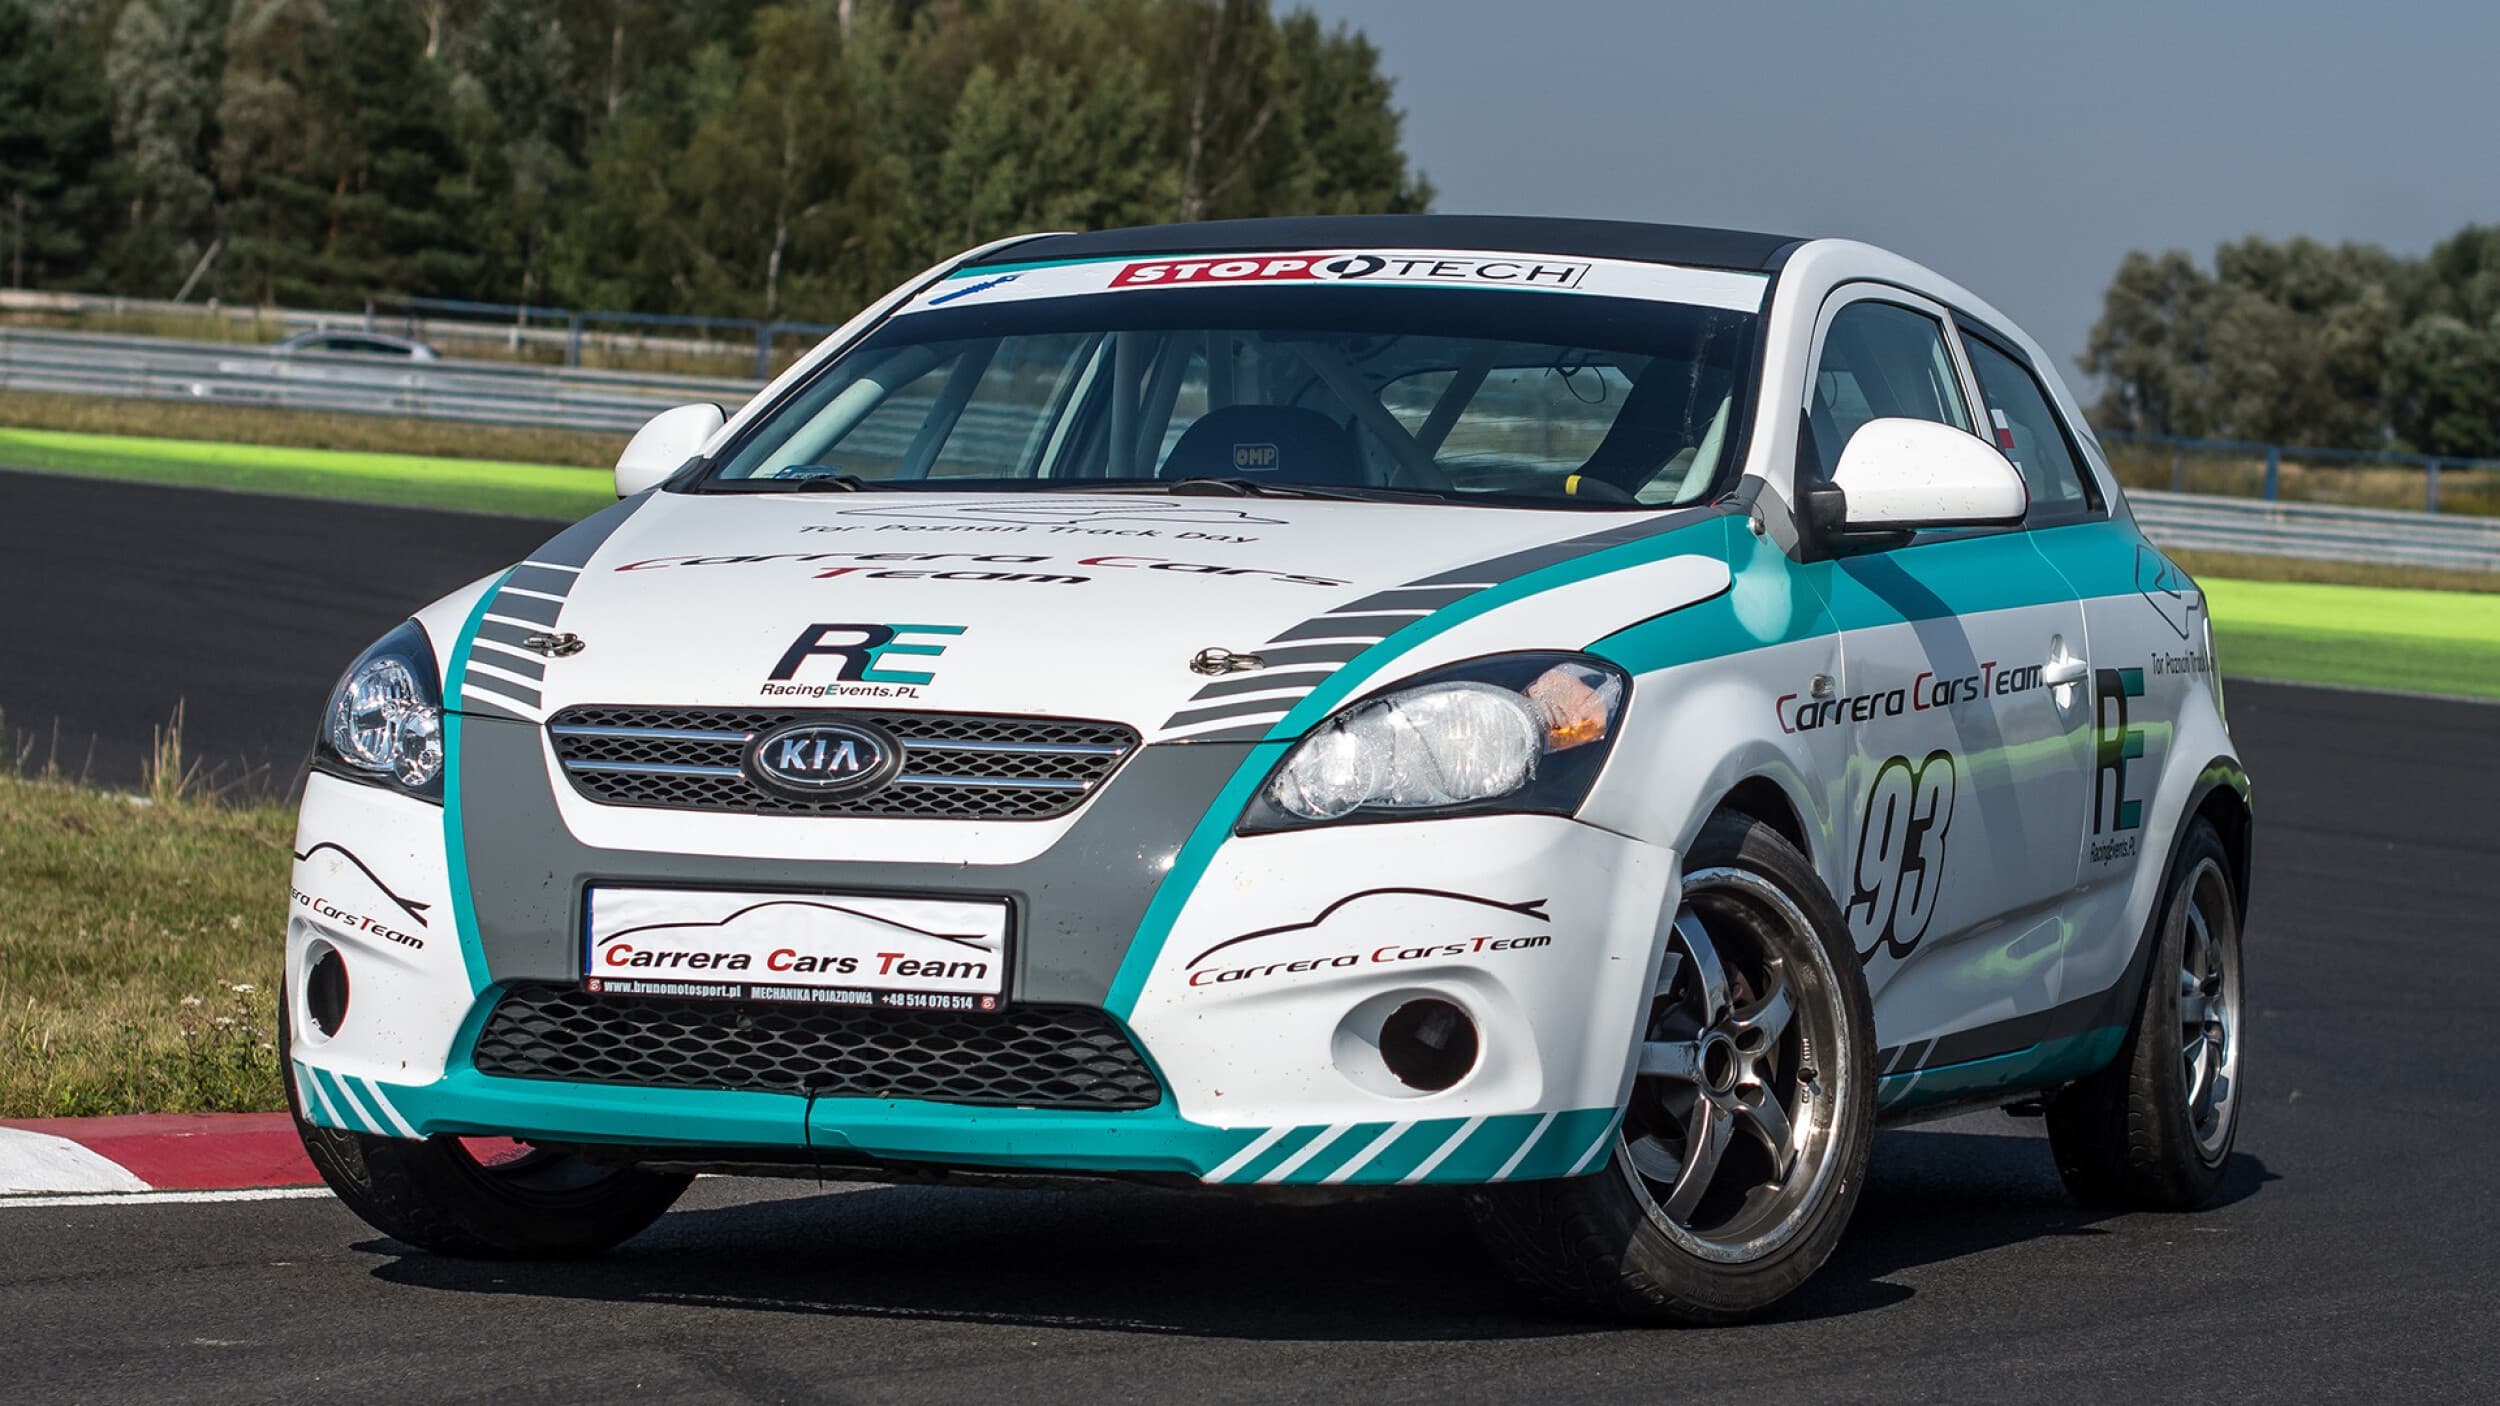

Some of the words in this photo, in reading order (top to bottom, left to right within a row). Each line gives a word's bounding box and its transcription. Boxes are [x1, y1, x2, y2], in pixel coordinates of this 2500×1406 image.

[1126, 261, 1314, 282] STOP
[1398, 260, 1575, 283] TECH
[1236, 447, 1275, 466] OMP
[800, 525, 864, 534] Tor
[1050, 526, 1162, 538] Track
[1175, 531, 1259, 543] Day
[812, 567, 1091, 584] Team
[1077, 556, 1353, 586] Cars
[767, 623, 969, 685] RE
[2151, 652, 2163, 674] Tor
[760, 683, 920, 699] RacingEvents.PL
[779, 739, 859, 771] KIA
[2093, 667, 2145, 834] RE
[1844, 749, 1956, 966] 93
[605, 943, 751, 971] Carrera
[766, 948, 859, 974] Cars
[875, 952, 989, 980] Team
[604, 981, 741, 998] www.brunomotosport.pl
[751, 987, 810, 1001] MECHANIKA
[812, 988, 873, 1004] POJAZDOWA
[882, 993, 904, 1006] +48
[906, 994, 927, 1007] 514
[929, 995, 951, 1008] 076
[952, 996, 973, 1009] 514
